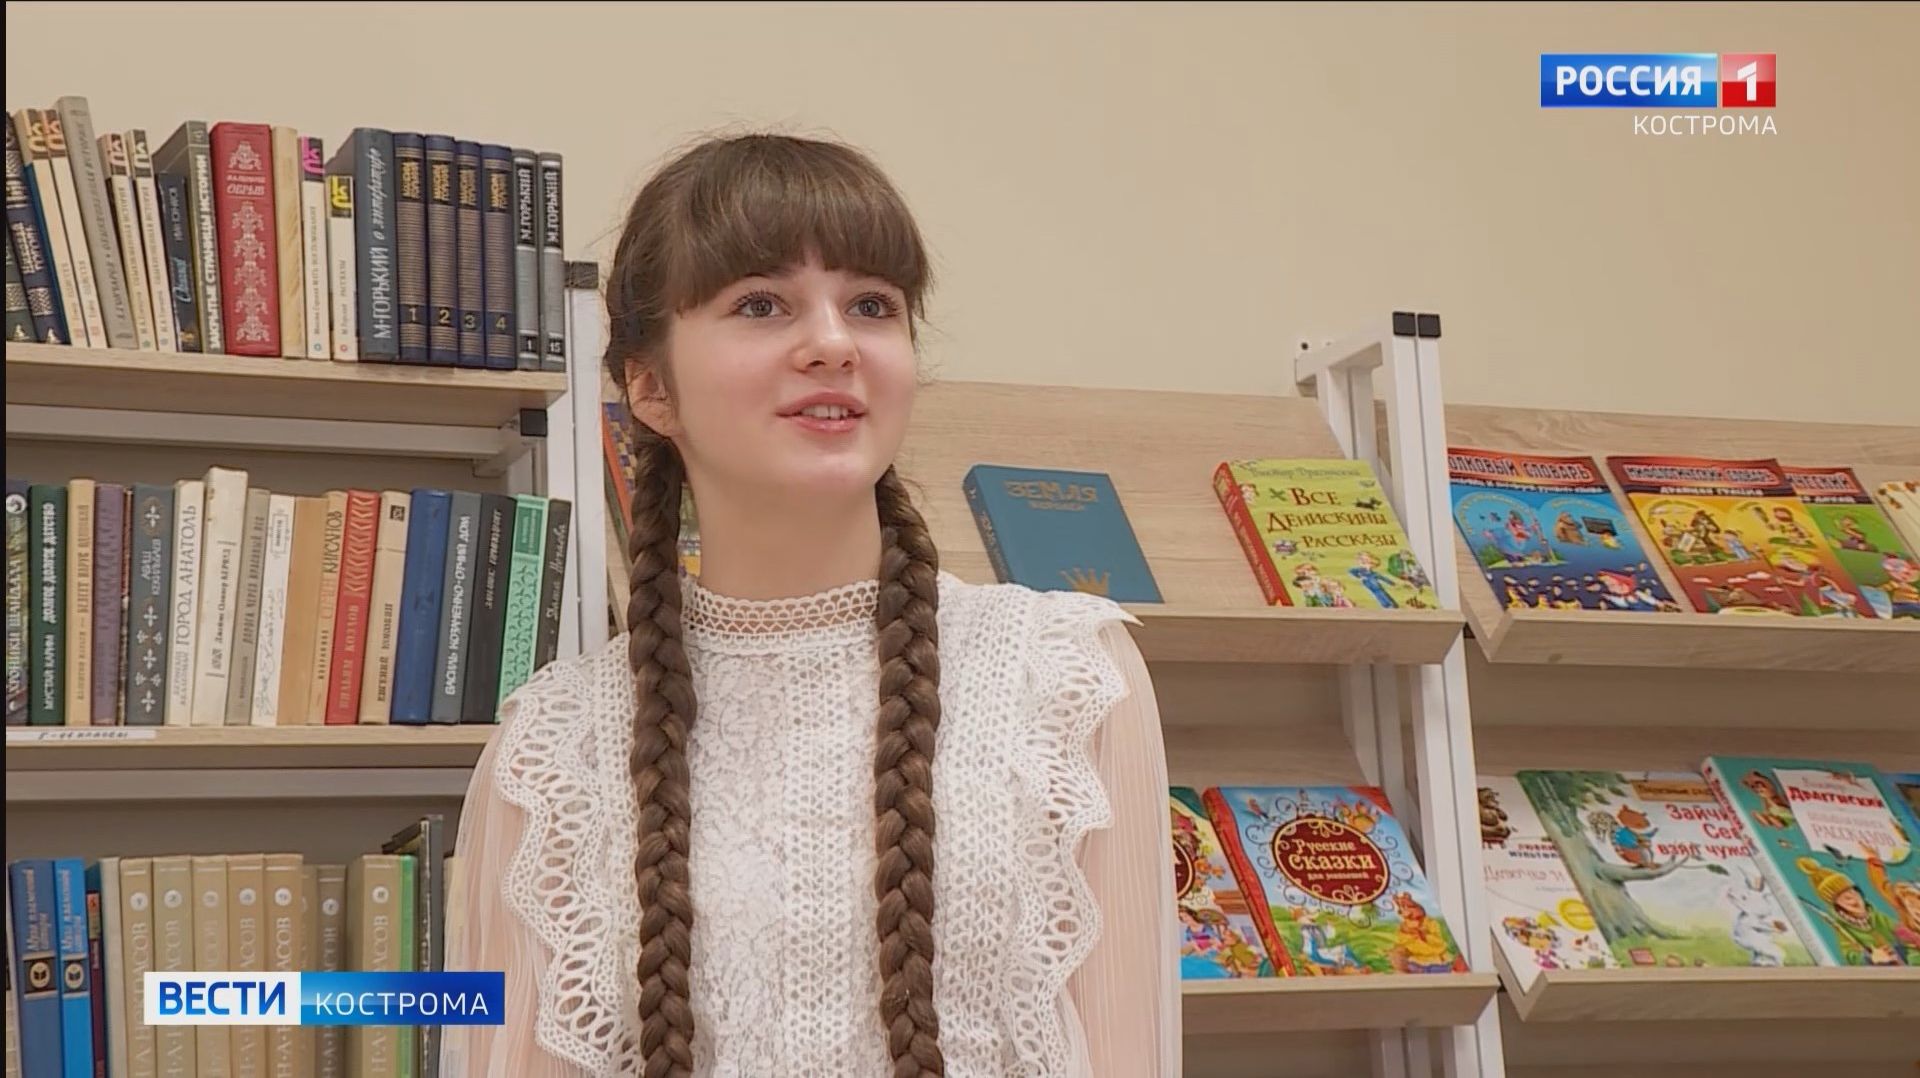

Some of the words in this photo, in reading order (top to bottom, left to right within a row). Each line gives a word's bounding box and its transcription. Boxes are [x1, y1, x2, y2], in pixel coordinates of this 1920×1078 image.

[195, 155, 210, 212] ИСТОРИИ
[200, 215, 216, 282] СТРАНИЦЫ
[205, 286, 220, 349] ЗАКРЫТЫЕ
[1005, 481, 1098, 503] ЗЕМЛЯ
[1522, 462, 1593, 480] СЛОВАРЬ
[43, 503, 57, 545] ДЕТСТВО
[179, 505, 197, 585] АНАТОЛЬ
[175, 590, 193, 646] ГОРОД
[1288, 853, 1377, 871] Сказки
[1291, 838, 1356, 855] Русские
